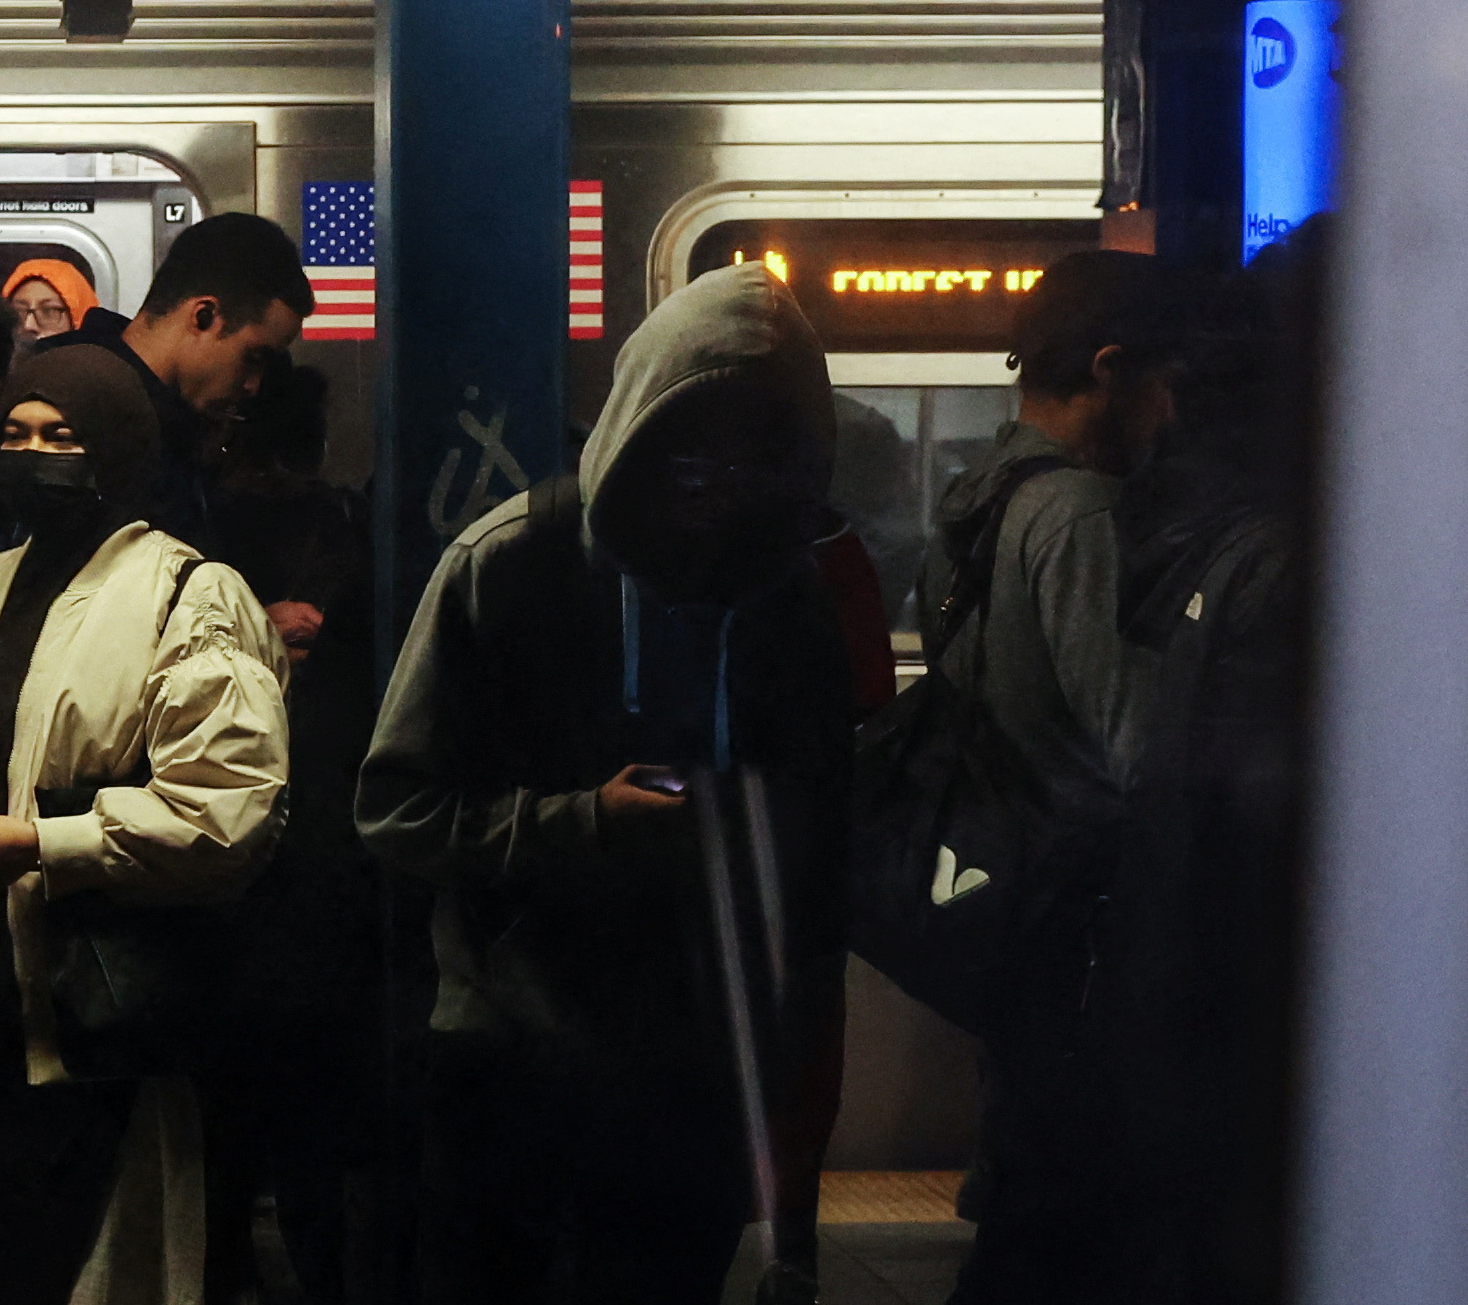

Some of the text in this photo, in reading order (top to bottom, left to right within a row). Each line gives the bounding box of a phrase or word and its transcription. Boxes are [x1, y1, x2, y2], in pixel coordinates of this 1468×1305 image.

[0, 200, 20, 212] not
[22, 200, 50, 212] hold
[52, 200, 88, 212] doors
[165, 204, 185, 222] L7
